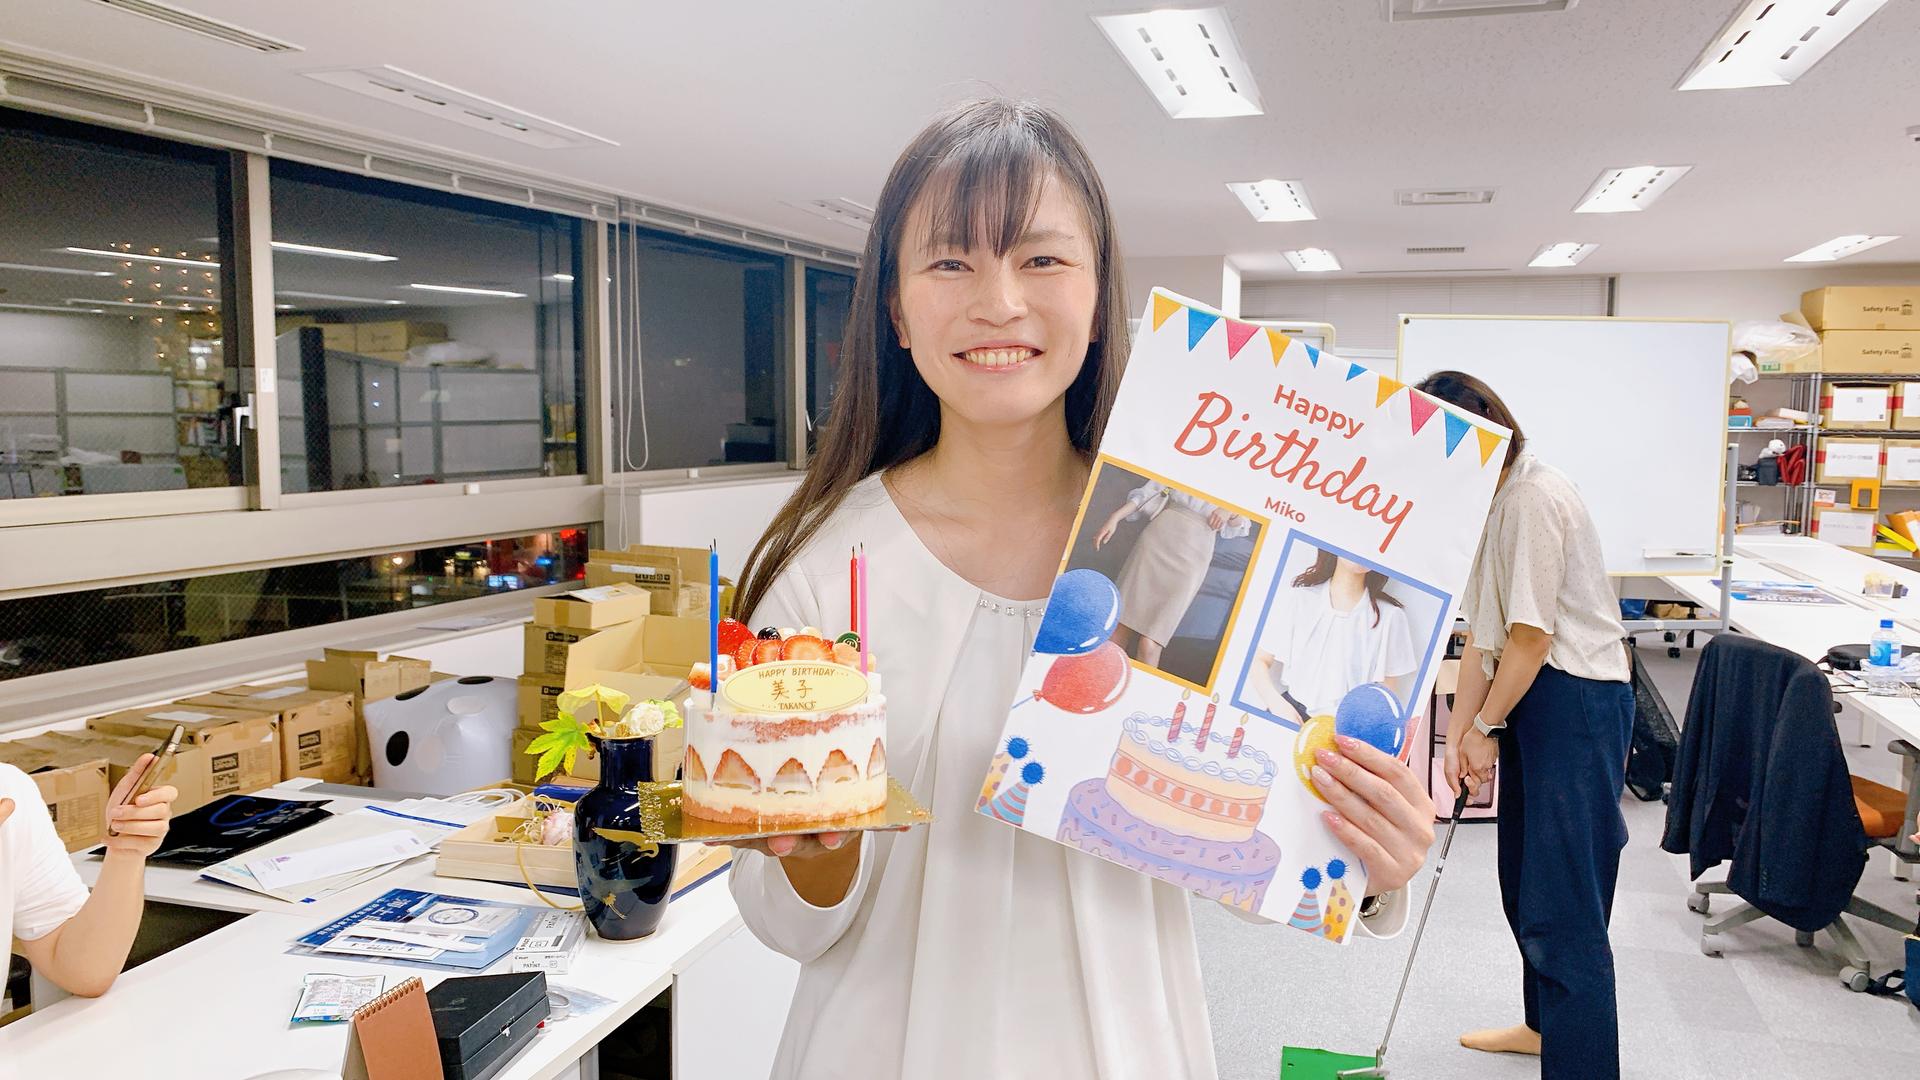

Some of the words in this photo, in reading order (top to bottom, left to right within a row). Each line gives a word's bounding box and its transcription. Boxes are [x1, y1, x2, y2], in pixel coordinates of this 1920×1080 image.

[1862, 305, 1883, 314] Safety
[1862, 348, 1883, 357] Safety
[1273, 384, 1365, 439] Happy
[1174, 391, 1414, 554] Birthday
[1264, 496, 1306, 523] Miko
[759, 669, 786, 679] HAPPY
[791, 667, 836, 677] BIRTHDAY
[771, 680, 813, 700] 美子
